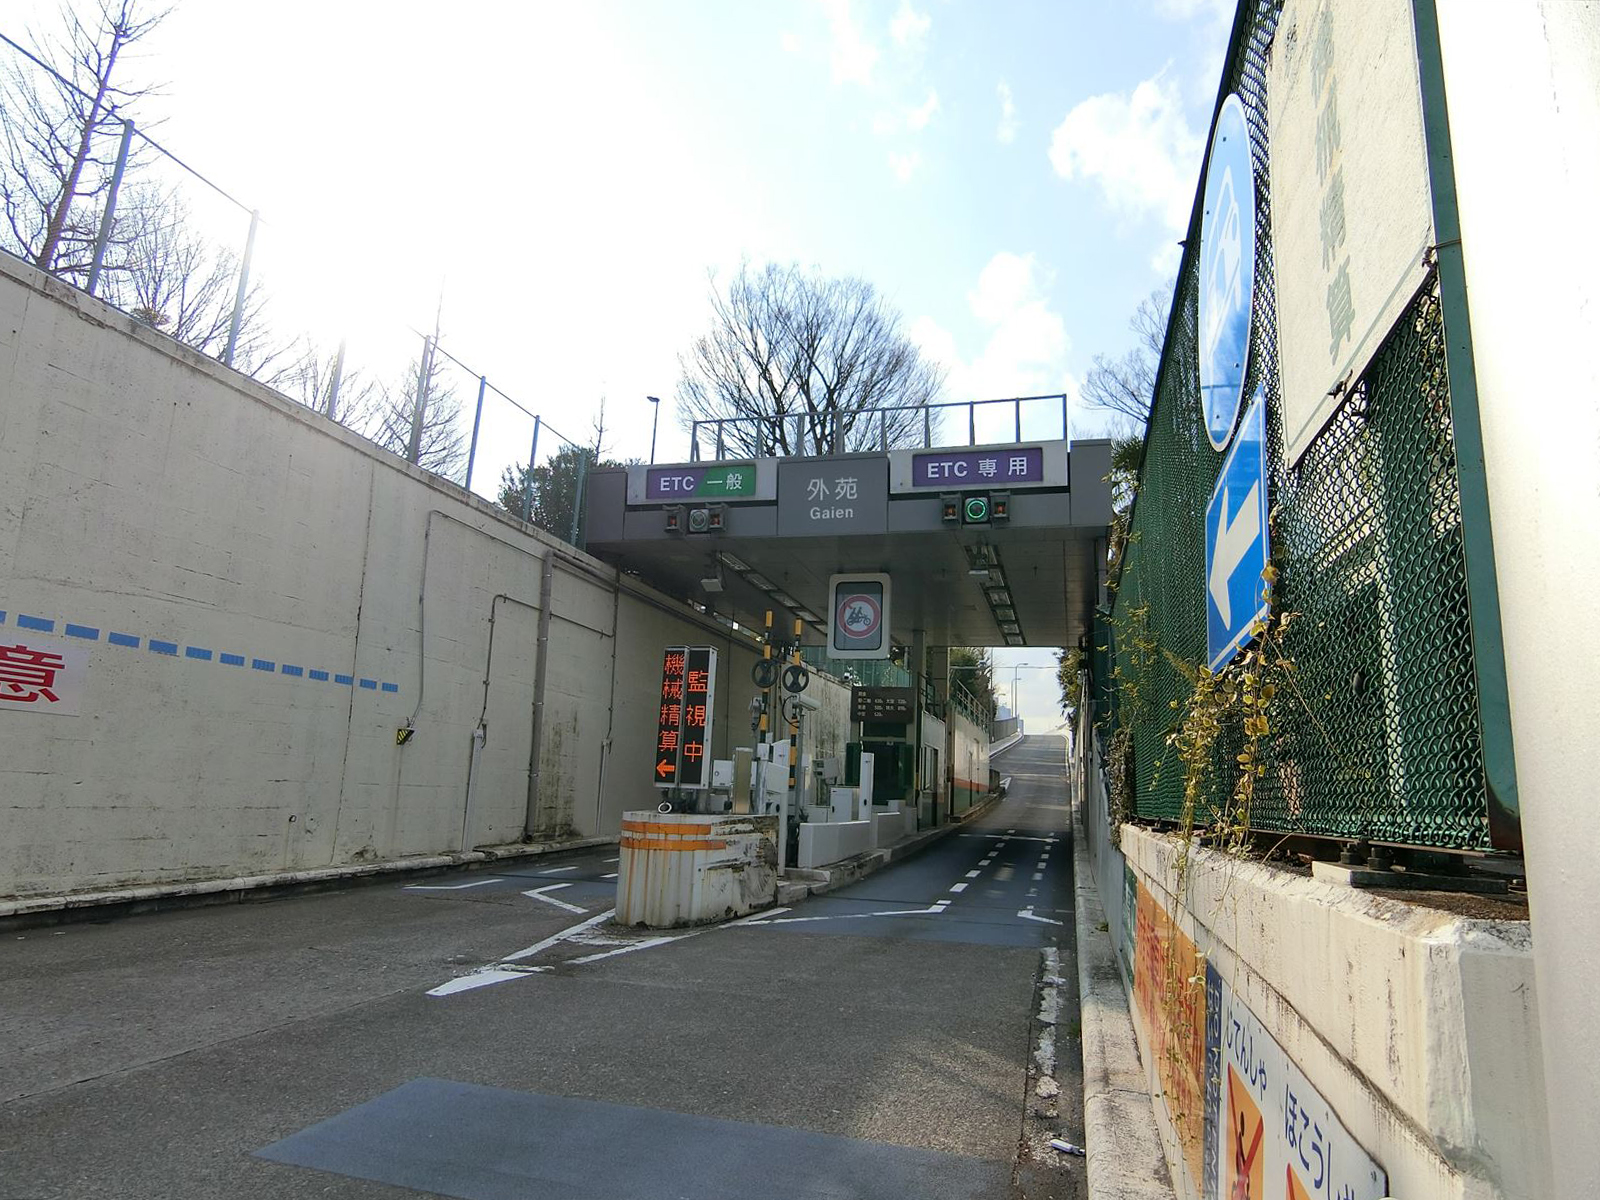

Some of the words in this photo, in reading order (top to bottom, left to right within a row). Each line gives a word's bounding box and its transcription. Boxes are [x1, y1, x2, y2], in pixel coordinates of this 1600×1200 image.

[927, 462, 969, 479] ETC
[978, 457, 1028, 477] 専用
[660, 477, 695, 492] ETC
[706, 472, 743, 491] 一般
[807, 477, 858, 503] 外苑
[810, 506, 854, 521] Gaien
[658, 653, 685, 752] 機械精算
[684, 670, 709, 763] 監視中
[1226, 1005, 1267, 1101] じてんしゃ
